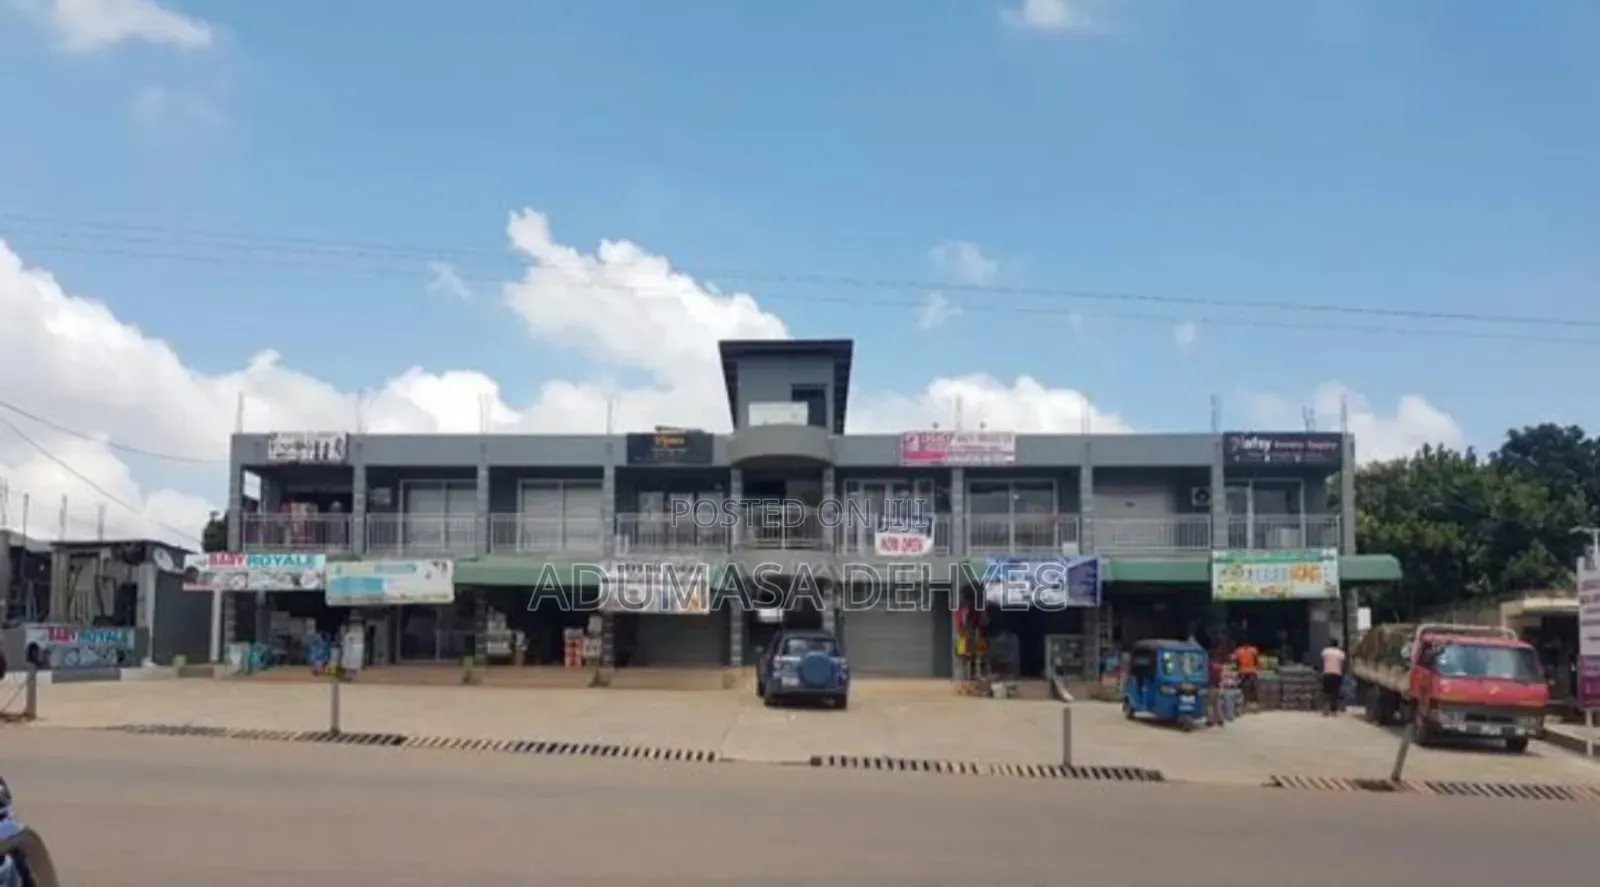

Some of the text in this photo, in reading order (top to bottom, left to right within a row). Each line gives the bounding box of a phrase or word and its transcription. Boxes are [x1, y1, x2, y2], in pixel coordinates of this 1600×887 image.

[207, 553, 315, 567] BABY ROYALE
[47, 627, 128, 643] BABY ROYALE
